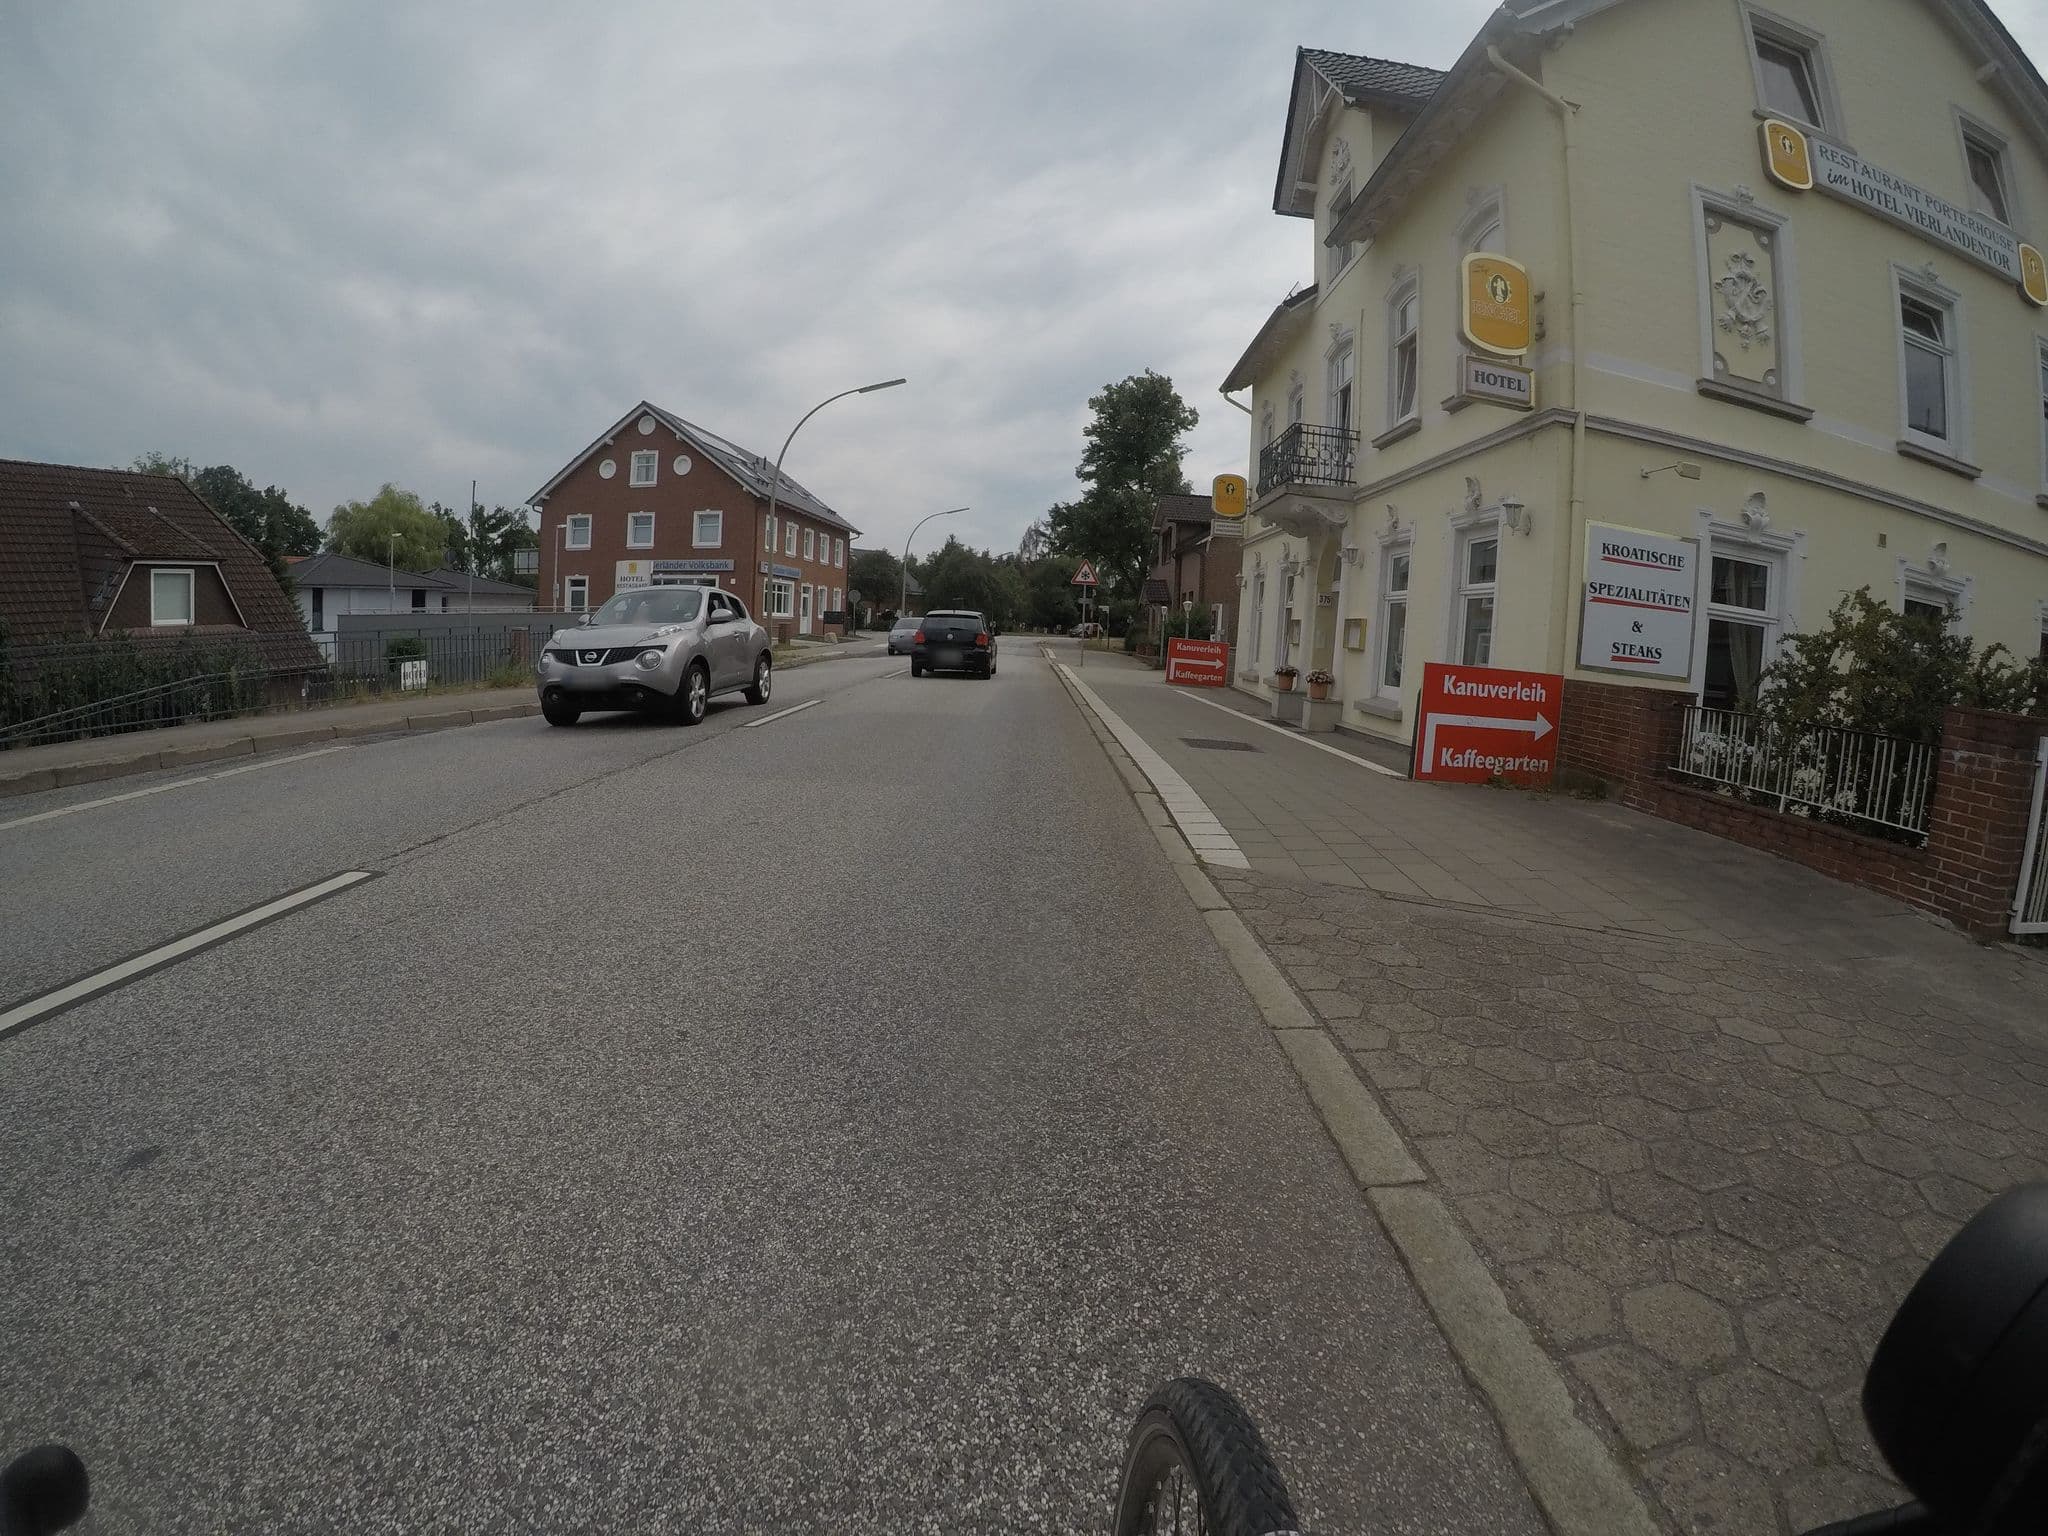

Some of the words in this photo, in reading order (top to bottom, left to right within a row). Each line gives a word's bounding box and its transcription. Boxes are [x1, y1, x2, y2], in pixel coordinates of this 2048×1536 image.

[1819, 145, 1921, 202] RESTAURANT
[1925, 194, 2015, 253] PORTERHOUSE
[1827, 168, 1849, 186] im
[1851, 178, 1902, 215] HOTEL
[1904, 202, 2010, 272] VIERLANDENTOR
[1474, 370, 1526, 393] HOTEL
[689, 560, 729, 570] Volksbank
[1602, 542, 1685, 568] KROATISCHE
[620, 575, 645, 583] HOTEL
[1588, 581, 1691, 609] SPEZIALITÄTEN
[1631, 620, 1644, 634] &
[1176, 642, 1222, 655] Kanuverleih
[1611, 641, 1662, 660] STEAKS
[1175, 669, 1223, 682] Kaffeegarten
[1443, 674, 1546, 703] Kanuverleih
[1440, 747, 1549, 776] Kaffeegarten
